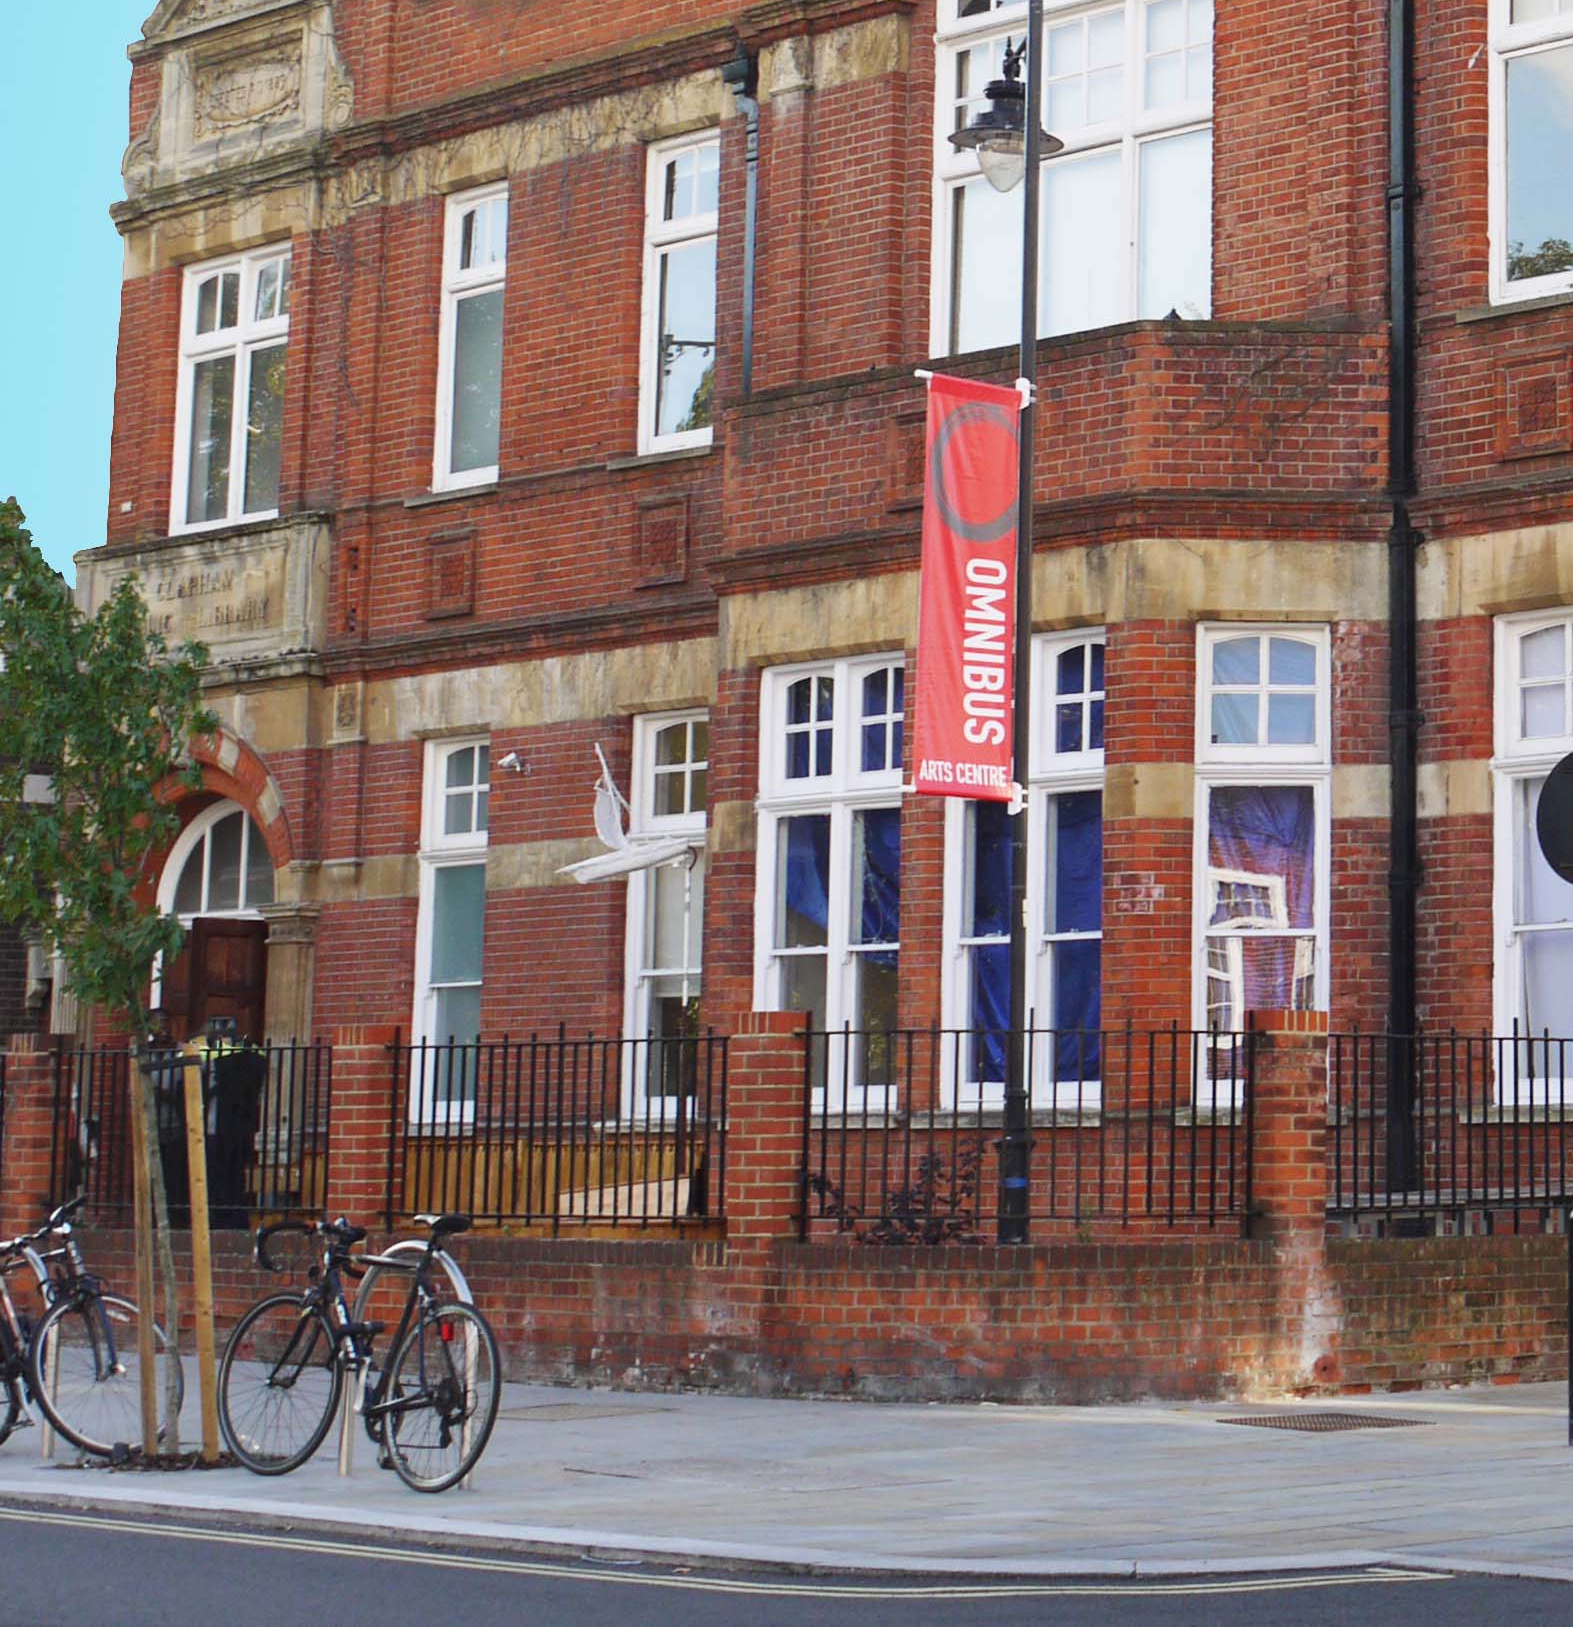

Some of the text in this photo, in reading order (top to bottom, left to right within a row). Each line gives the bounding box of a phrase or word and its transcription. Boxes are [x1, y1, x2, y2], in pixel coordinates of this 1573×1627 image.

[963, 557, 1007, 745] OMNIBUS
[919, 759, 1008, 788] ARTS CENTRE
